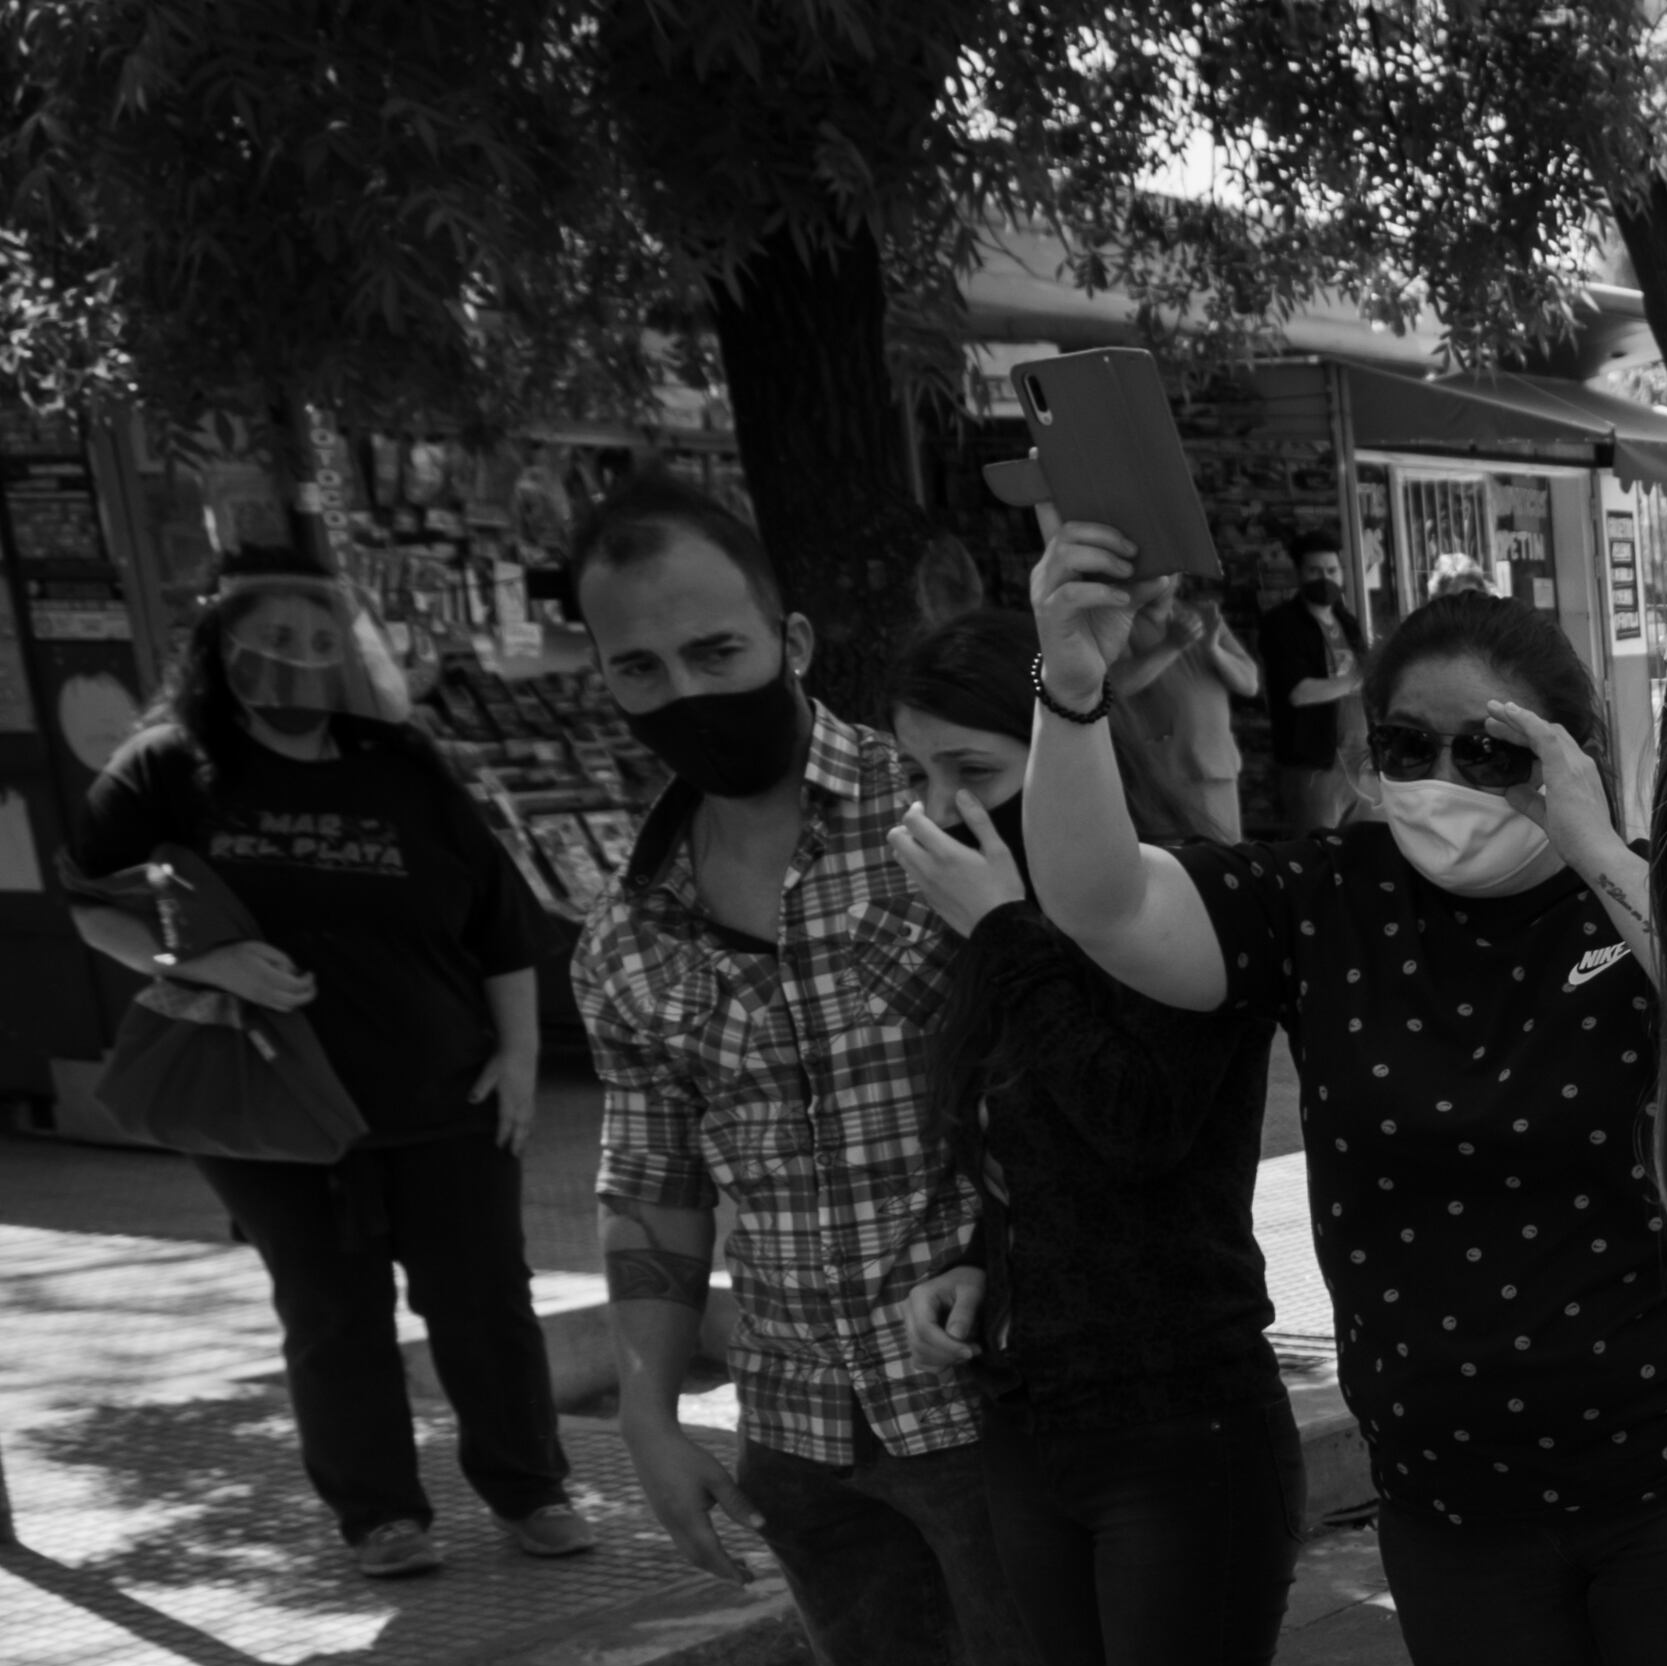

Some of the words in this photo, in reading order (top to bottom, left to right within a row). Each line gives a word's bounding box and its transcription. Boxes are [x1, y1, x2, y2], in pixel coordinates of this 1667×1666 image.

[254, 810, 342, 838] MAR
[290, 836, 404, 869] PLATA
[1578, 941, 1627, 970] NIKE
